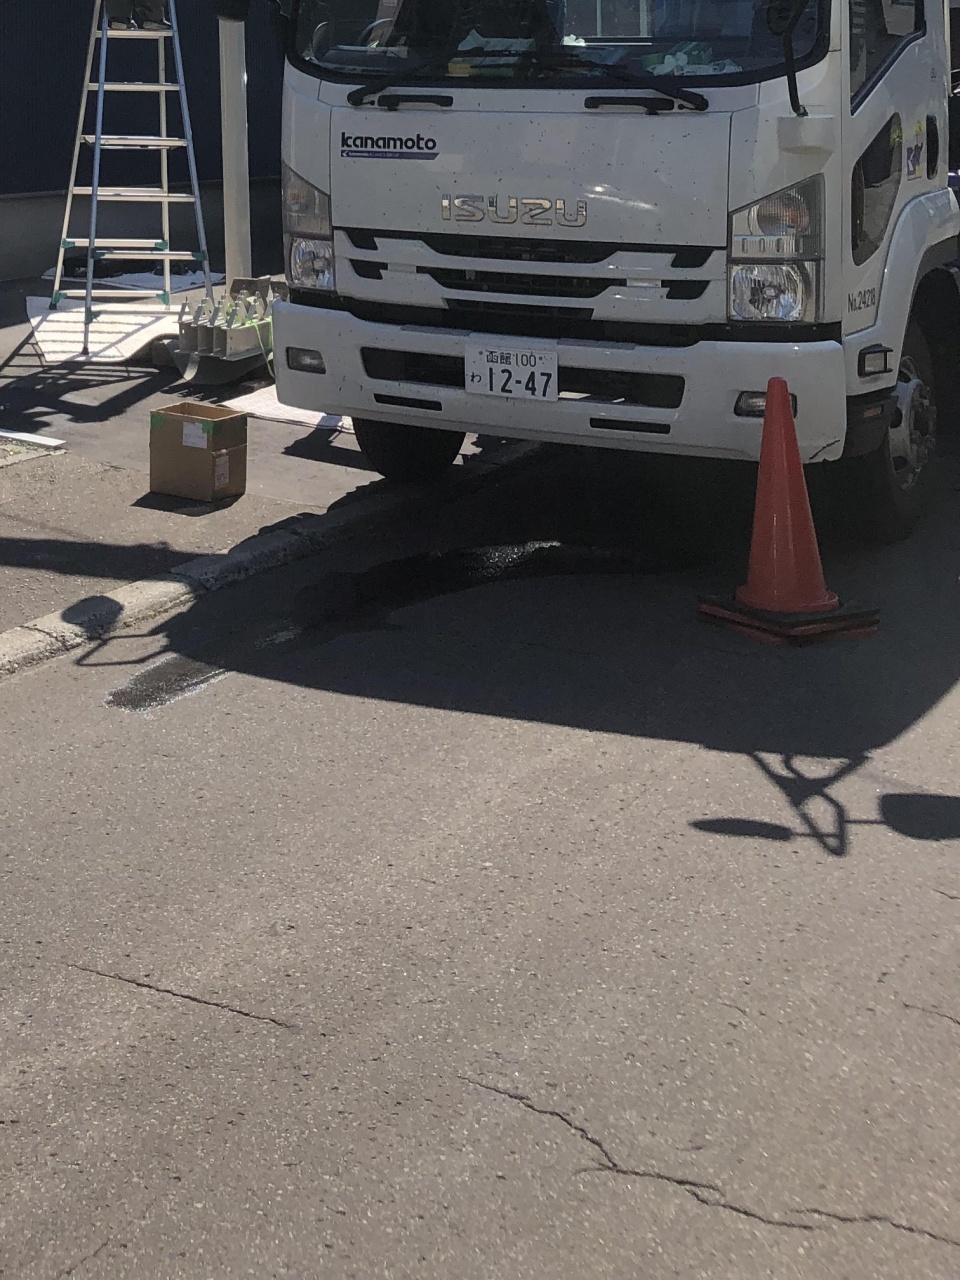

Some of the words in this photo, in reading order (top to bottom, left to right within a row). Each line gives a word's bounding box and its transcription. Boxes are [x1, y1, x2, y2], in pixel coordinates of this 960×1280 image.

[341, 131, 437, 150] kanamoto
[441, 193, 588, 227] ISUZU
[486, 350, 512, 366] 函館
[515, 353, 537, 367] 100
[471, 372, 482, 384] わ
[489, 367, 552, 398] 12-47
